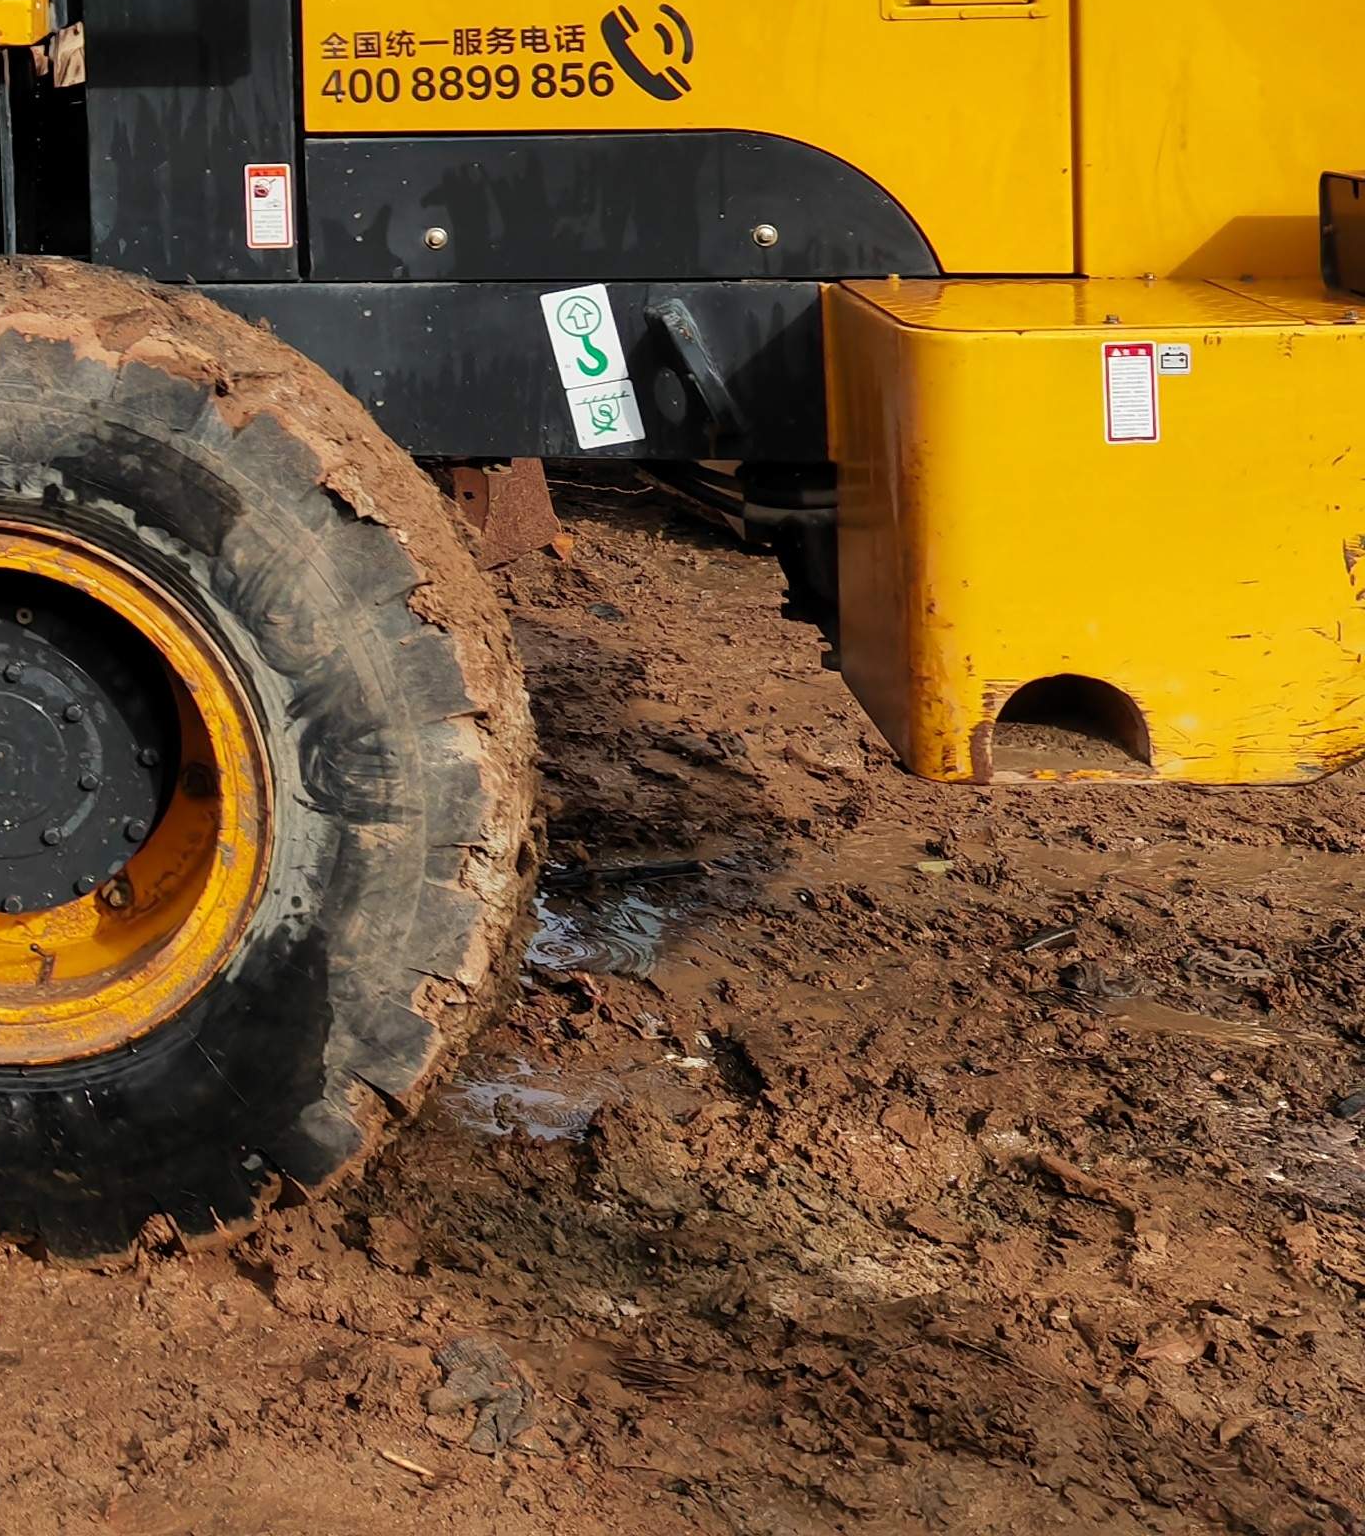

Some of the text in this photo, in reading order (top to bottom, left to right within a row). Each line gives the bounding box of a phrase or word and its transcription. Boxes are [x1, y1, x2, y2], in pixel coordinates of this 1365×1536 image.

[320, 24, 587, 62] 全国统一服务电话
[321, 61, 615, 105] 400 8899 856
